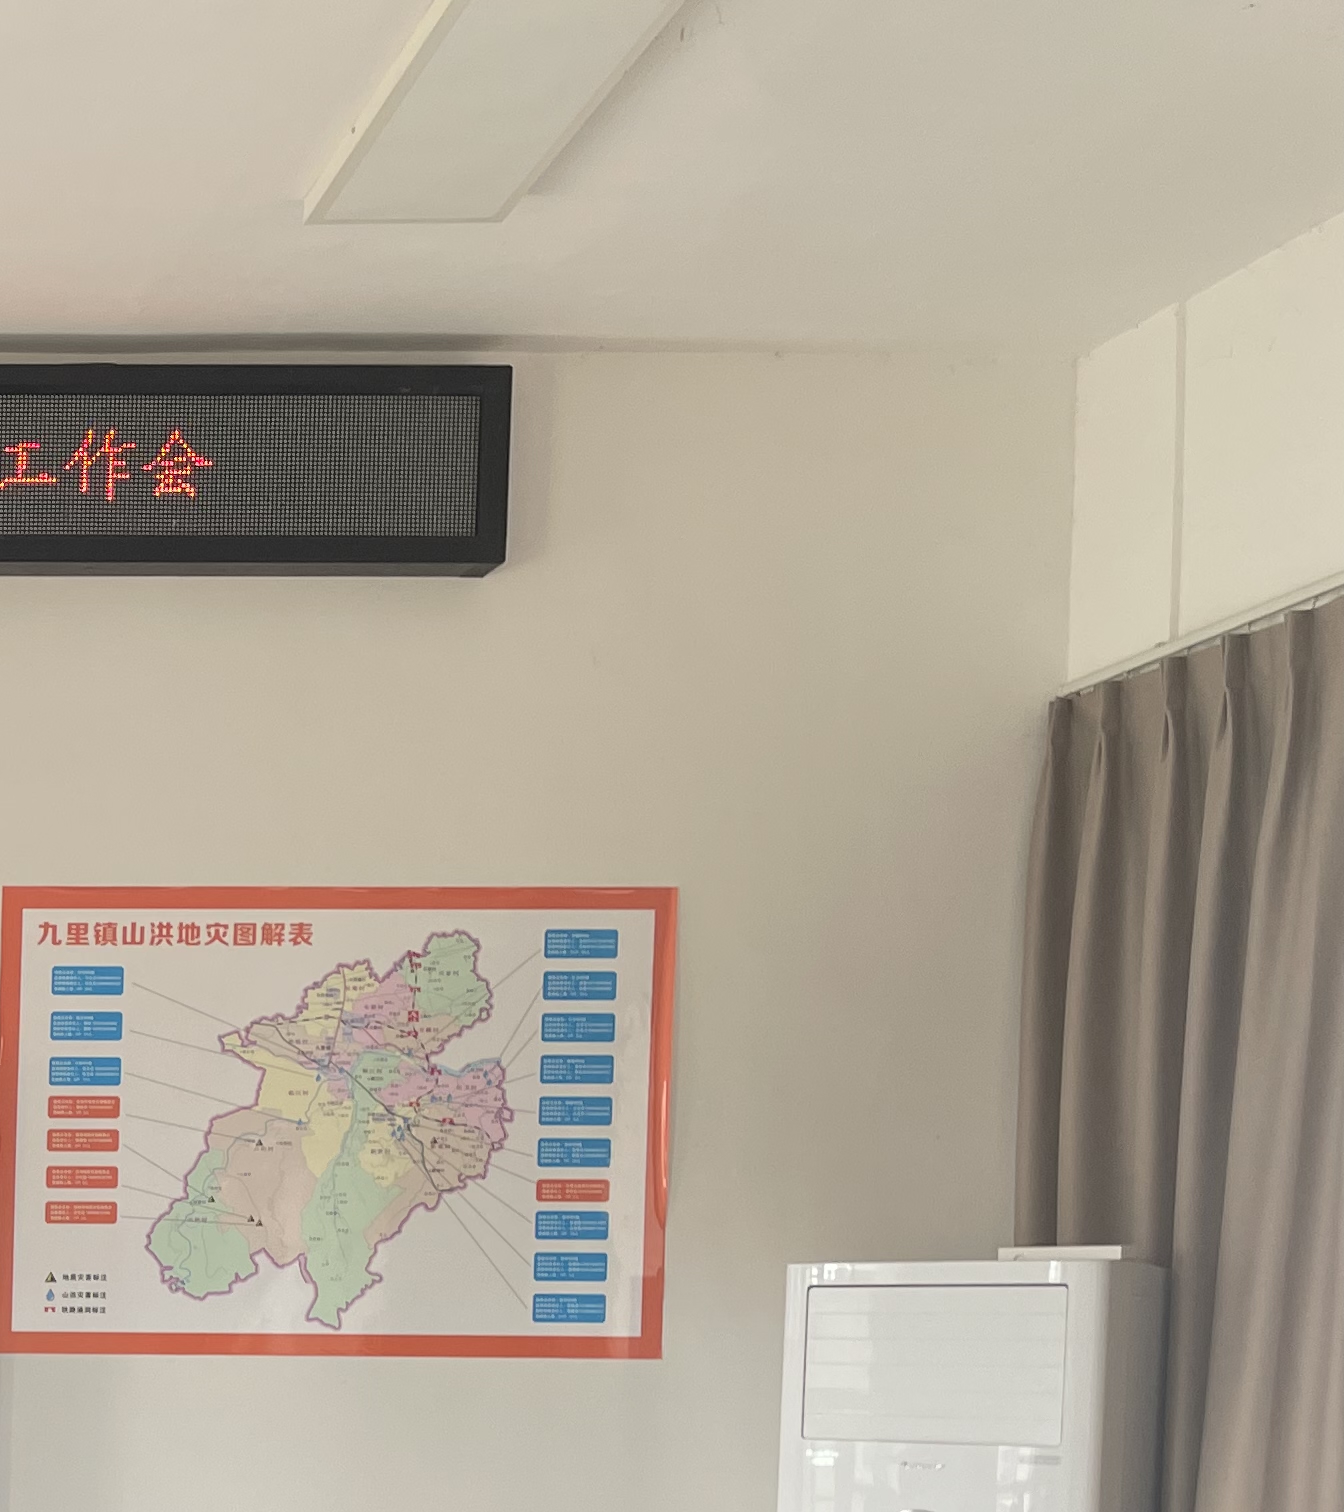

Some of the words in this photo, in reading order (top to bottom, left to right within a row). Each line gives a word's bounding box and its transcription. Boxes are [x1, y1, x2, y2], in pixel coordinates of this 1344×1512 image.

[37, 921, 313, 947] 九里镇山洪地灾图解表
